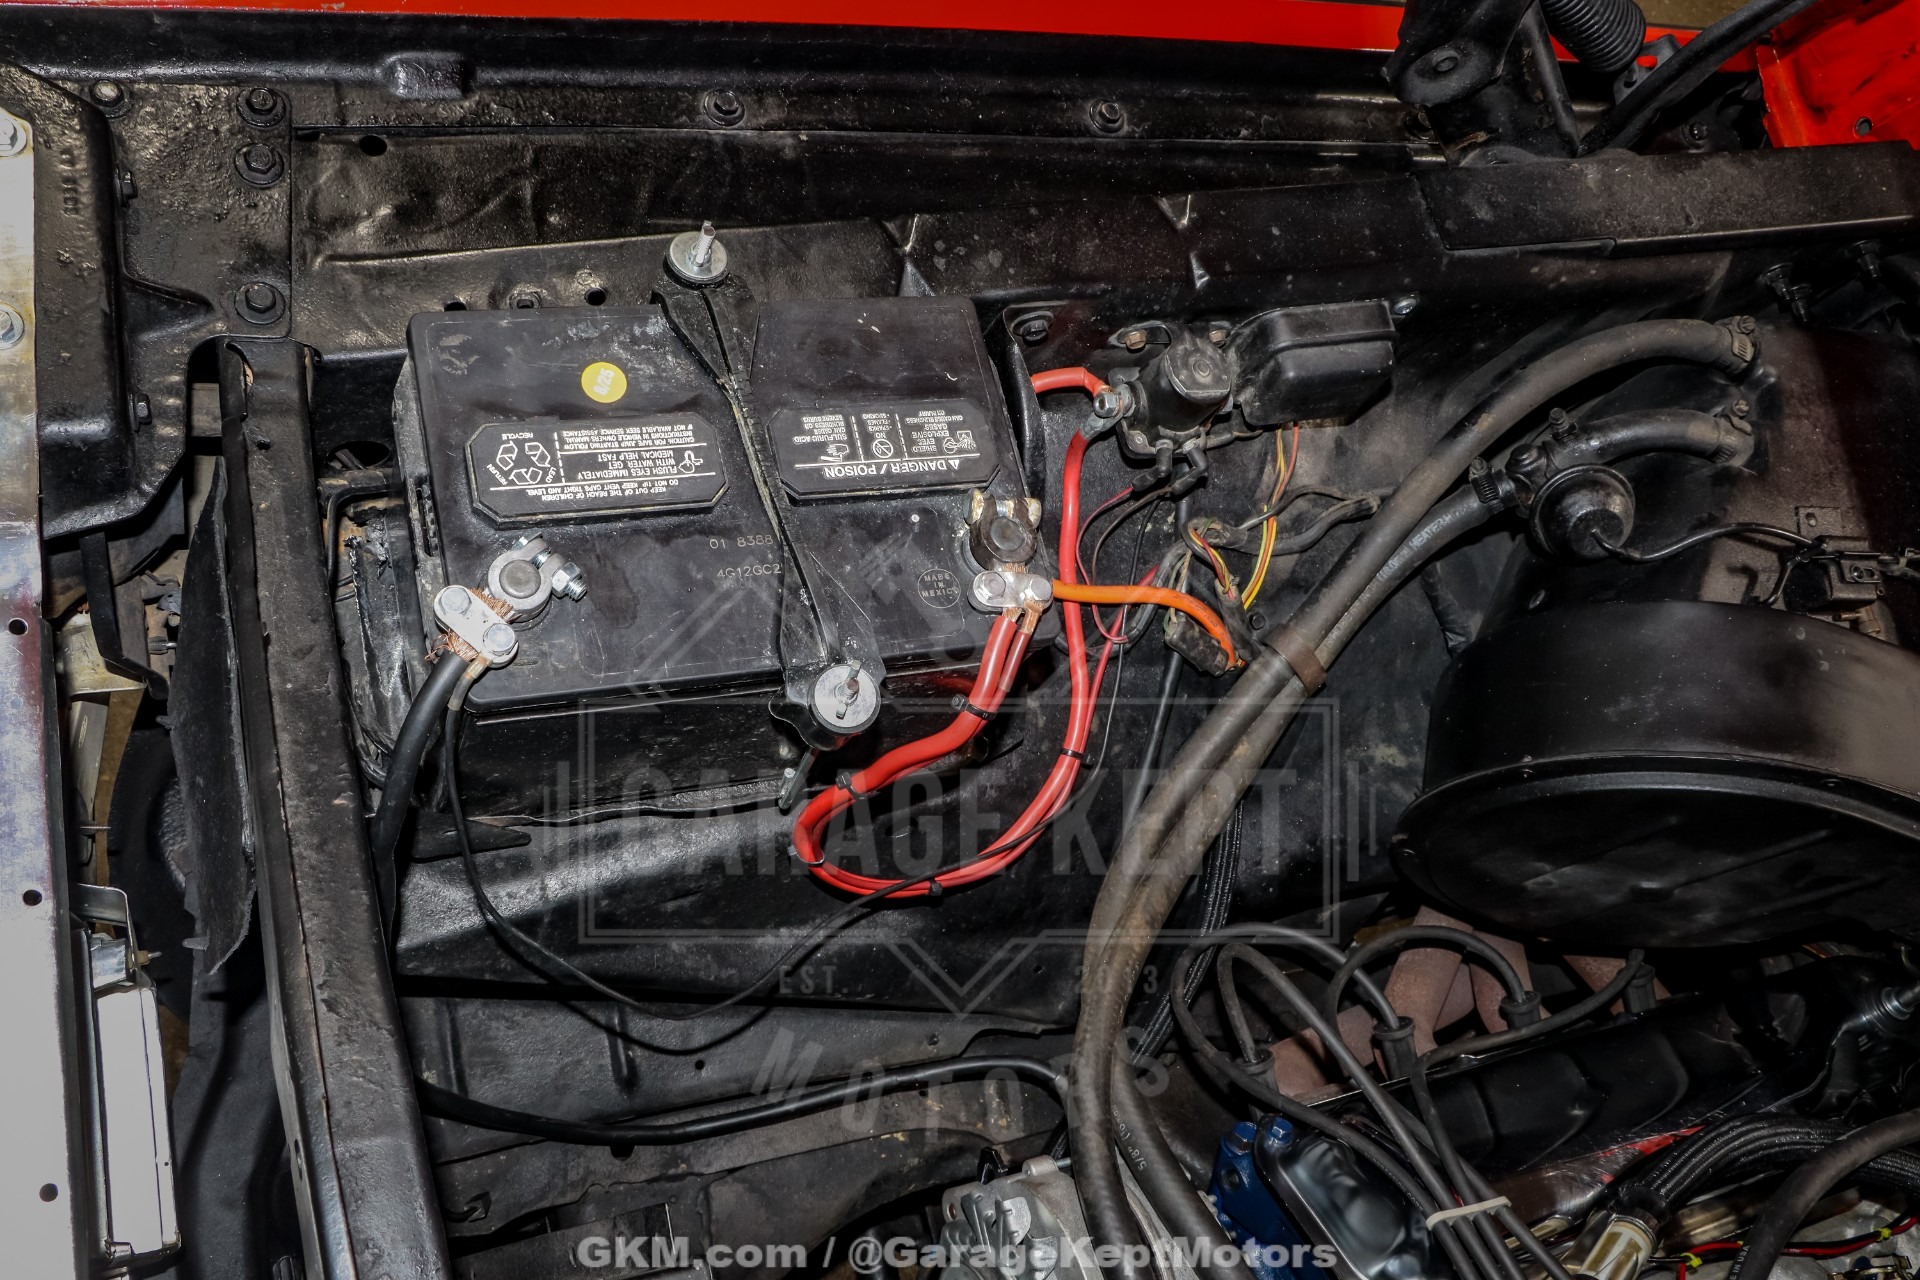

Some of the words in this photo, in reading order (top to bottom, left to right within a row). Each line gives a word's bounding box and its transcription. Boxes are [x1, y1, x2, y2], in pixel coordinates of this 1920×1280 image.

[593, 368, 615, 396] 8/25
[642, 425, 672, 433] AVAILABLE
[501, 432, 533, 440] RECYCLE
[651, 430, 692, 439] INSTRUCTIONS
[812, 433, 847, 442] SULFURIC
[912, 430, 949, 439] EXPLOSIVE
[590, 441, 619, 449] STARTING
[912, 445, 937, 453] SHIELD
[598, 453, 616, 462] FAST
[619, 452, 639, 460] HELP
[641, 449, 673, 458] MEDICAL
[608, 461, 624, 469] GET
[656, 458, 676, 466] WITH
[890, 460, 947, 473] DANGER
[486, 463, 508, 486] RETURN
[578, 469, 629, 480] IMMEDIATELY
[631, 468, 650, 476] EYES
[652, 466, 677, 474] FLUSH
[824, 464, 877, 478] POISON
[545, 467, 557, 483] LEAD
[542, 493, 574, 501] CHILDREN
[586, 490, 608, 498] REACH
[736, 534, 774, 547] 8388
[717, 563, 782, 578] 4G12GC2
[923, 573, 951, 582] MADE
[934, 581, 945, 589] IN
[921, 586, 959, 597] MEXICO
[1732, 1264, 1741, 1273] IN
[1737, 1246, 1751, 1262] USA
